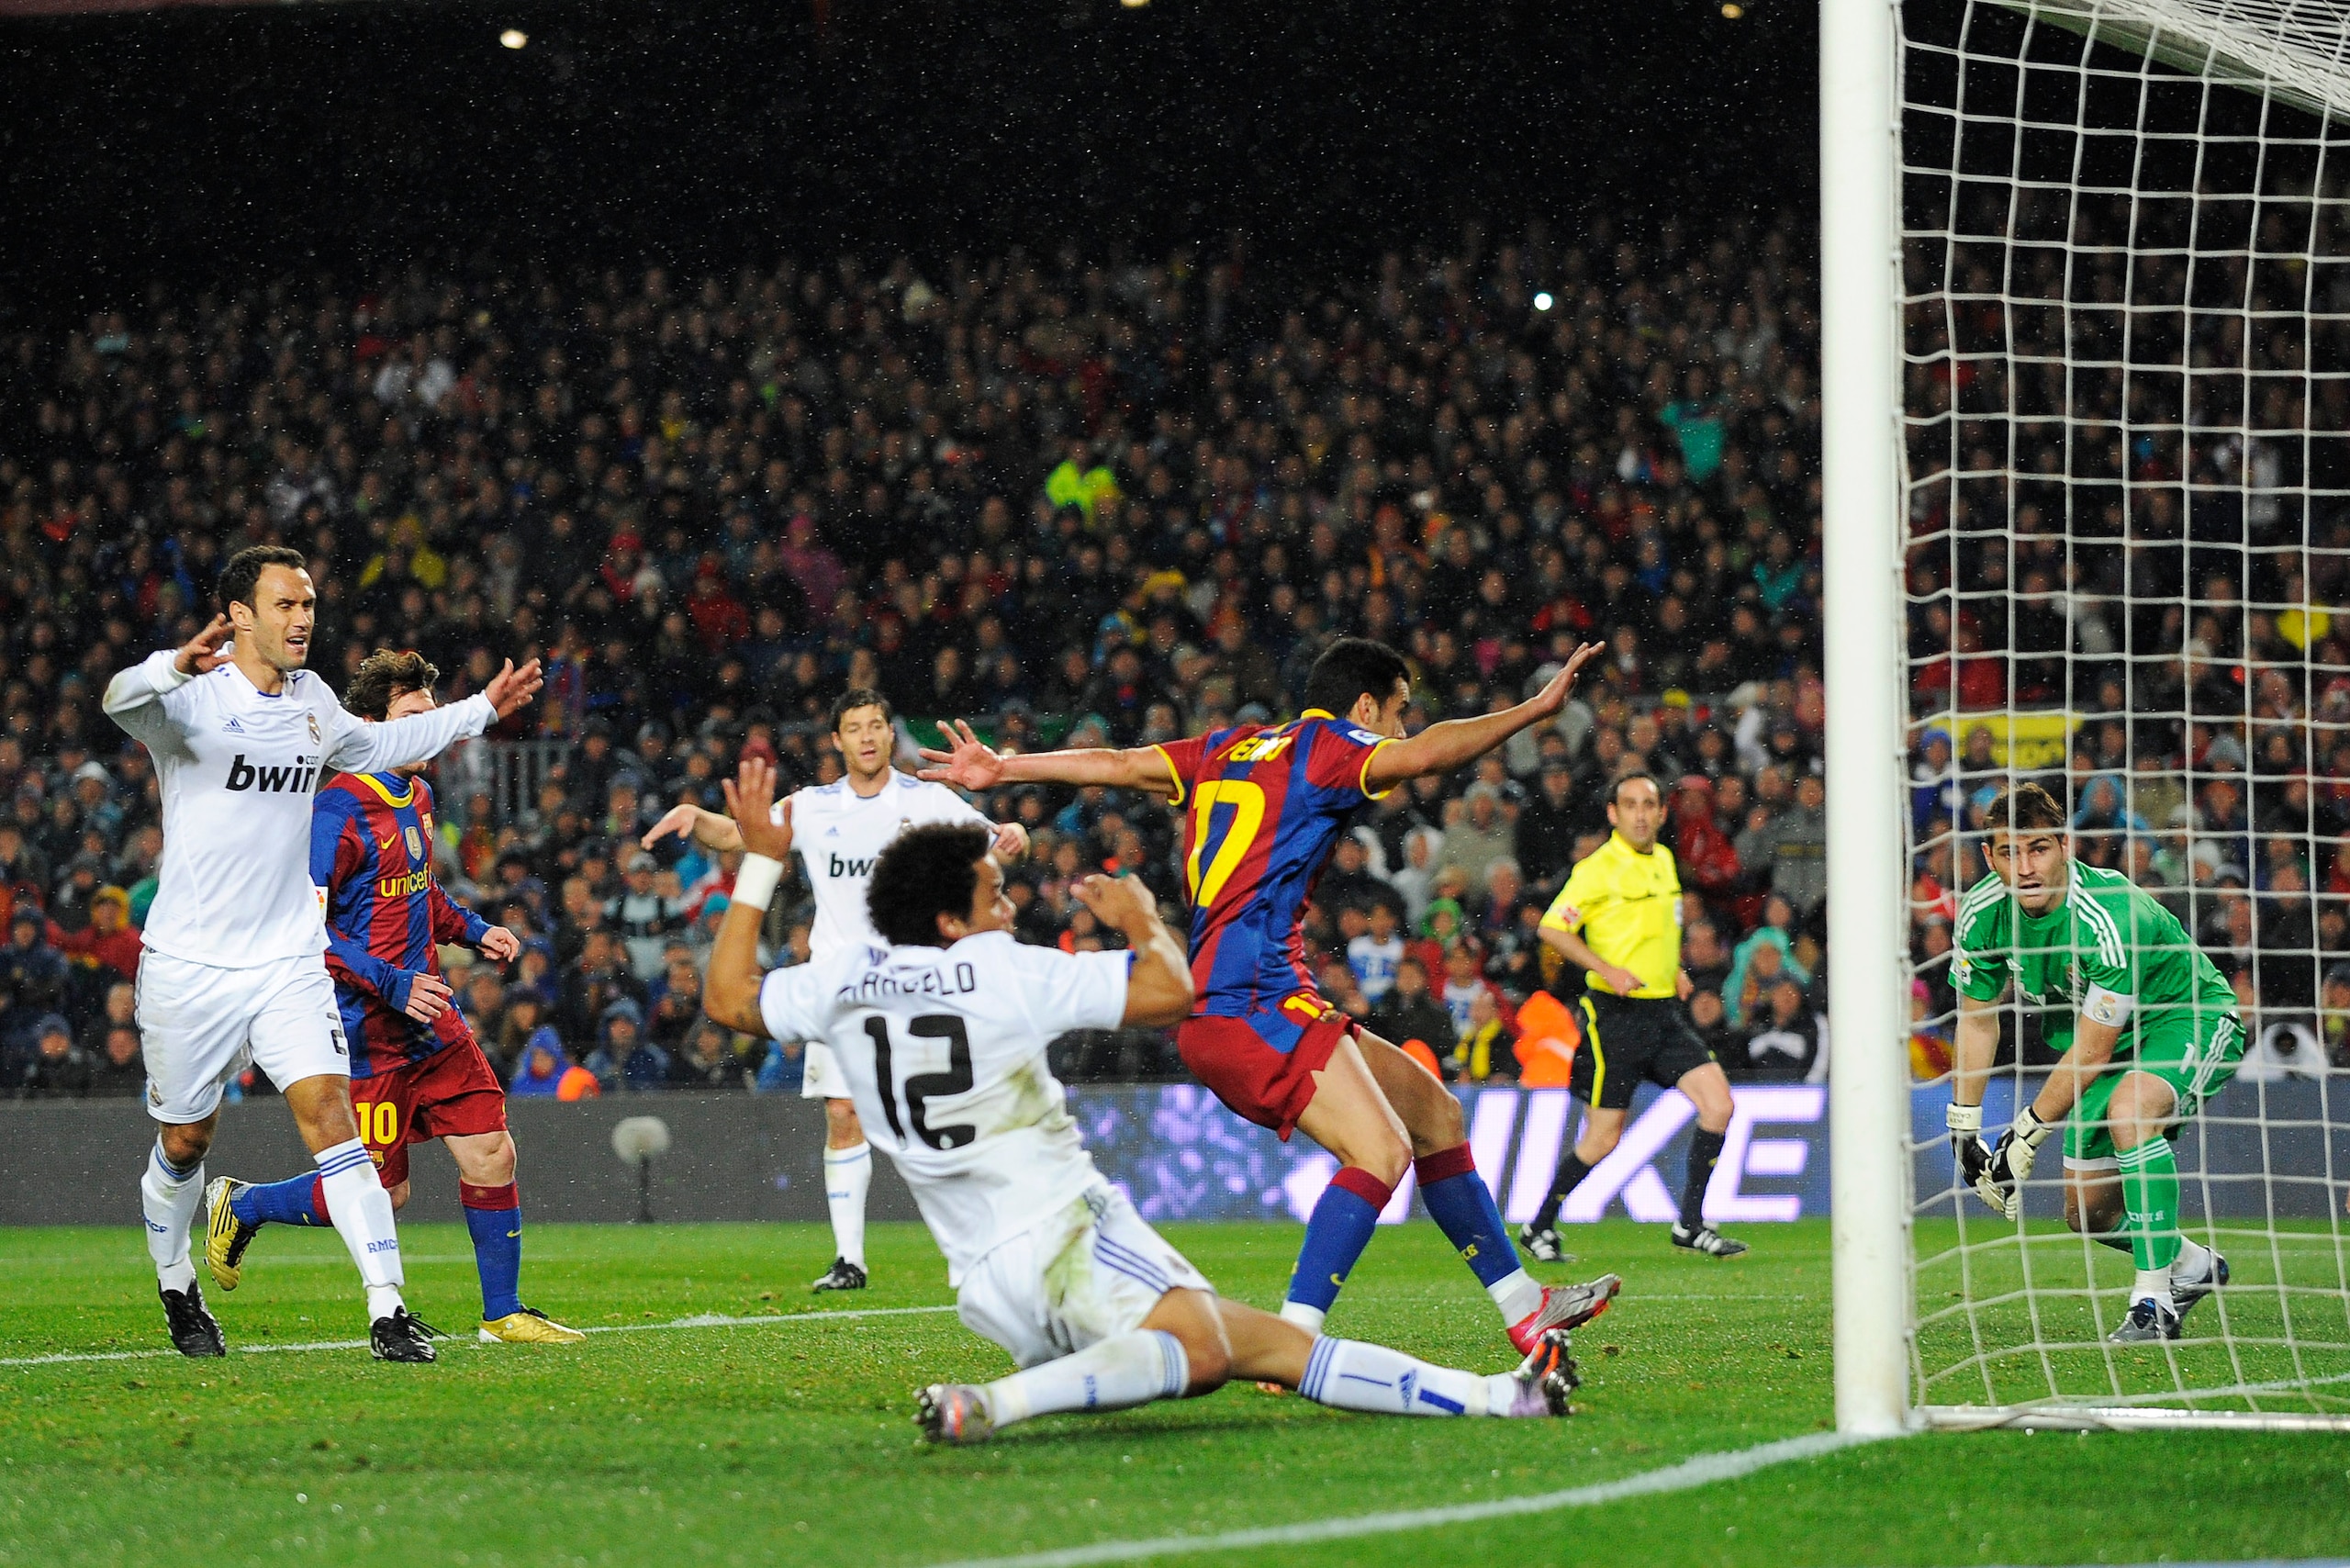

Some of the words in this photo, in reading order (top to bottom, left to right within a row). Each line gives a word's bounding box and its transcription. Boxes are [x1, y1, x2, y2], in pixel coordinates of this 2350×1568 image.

[830, 852, 878, 878] bw
[1187, 779, 1266, 908] 17
[381, 862, 429, 897] unicef
[865, 1015, 976, 1150] 12
[356, 1101, 397, 1145] 10
